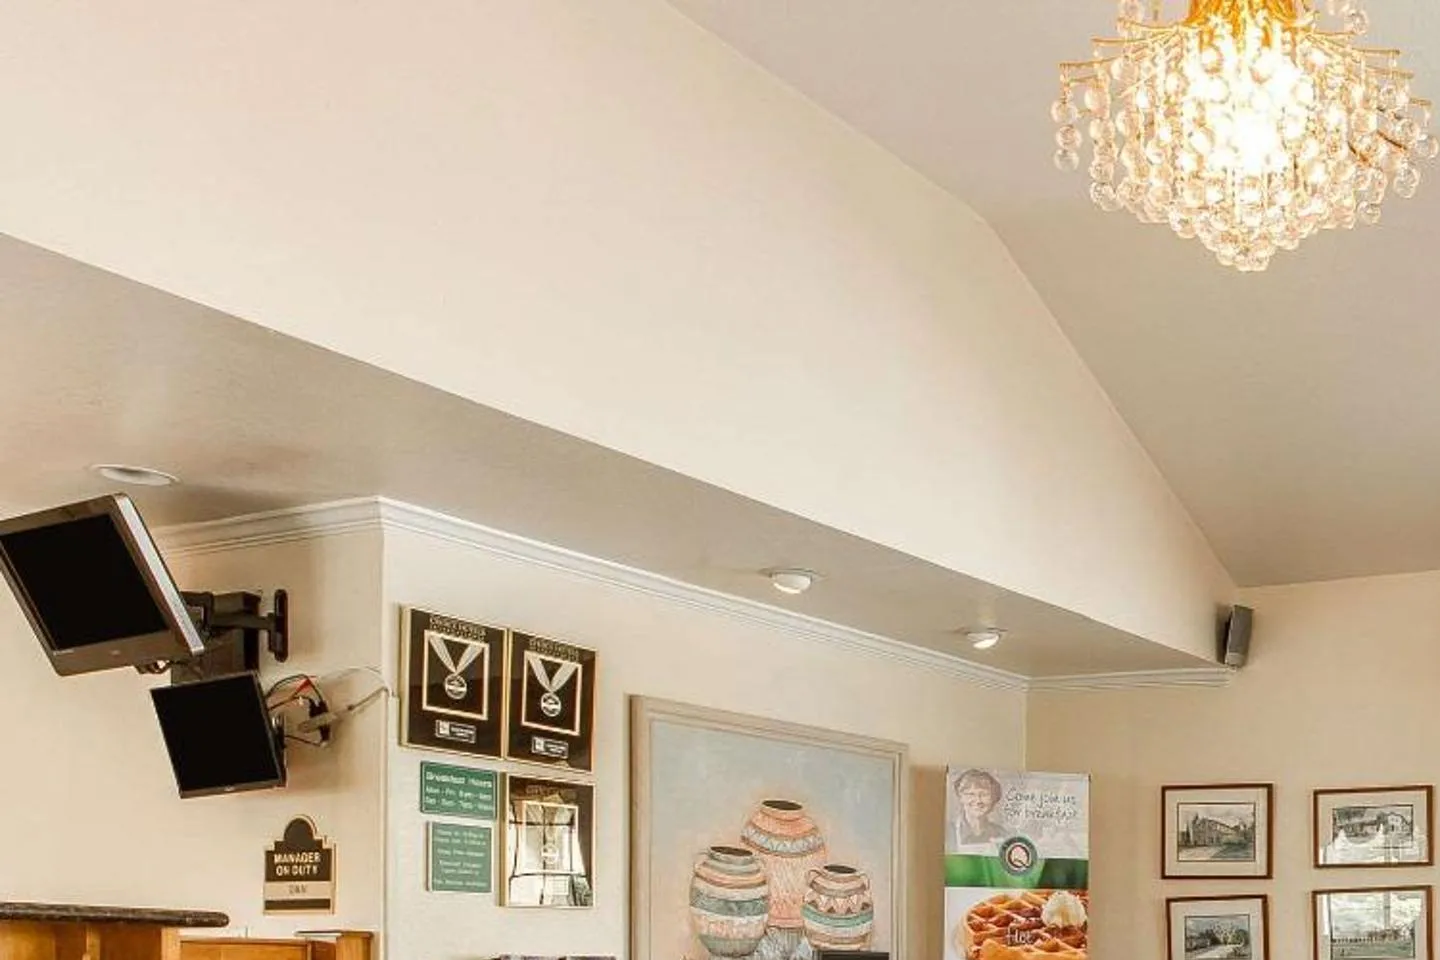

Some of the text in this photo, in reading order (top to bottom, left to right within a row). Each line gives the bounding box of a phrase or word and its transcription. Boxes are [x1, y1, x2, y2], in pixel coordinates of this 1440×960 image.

[273, 851, 321, 864] MANAGER
[275, 865, 318, 877] ON DUTY
